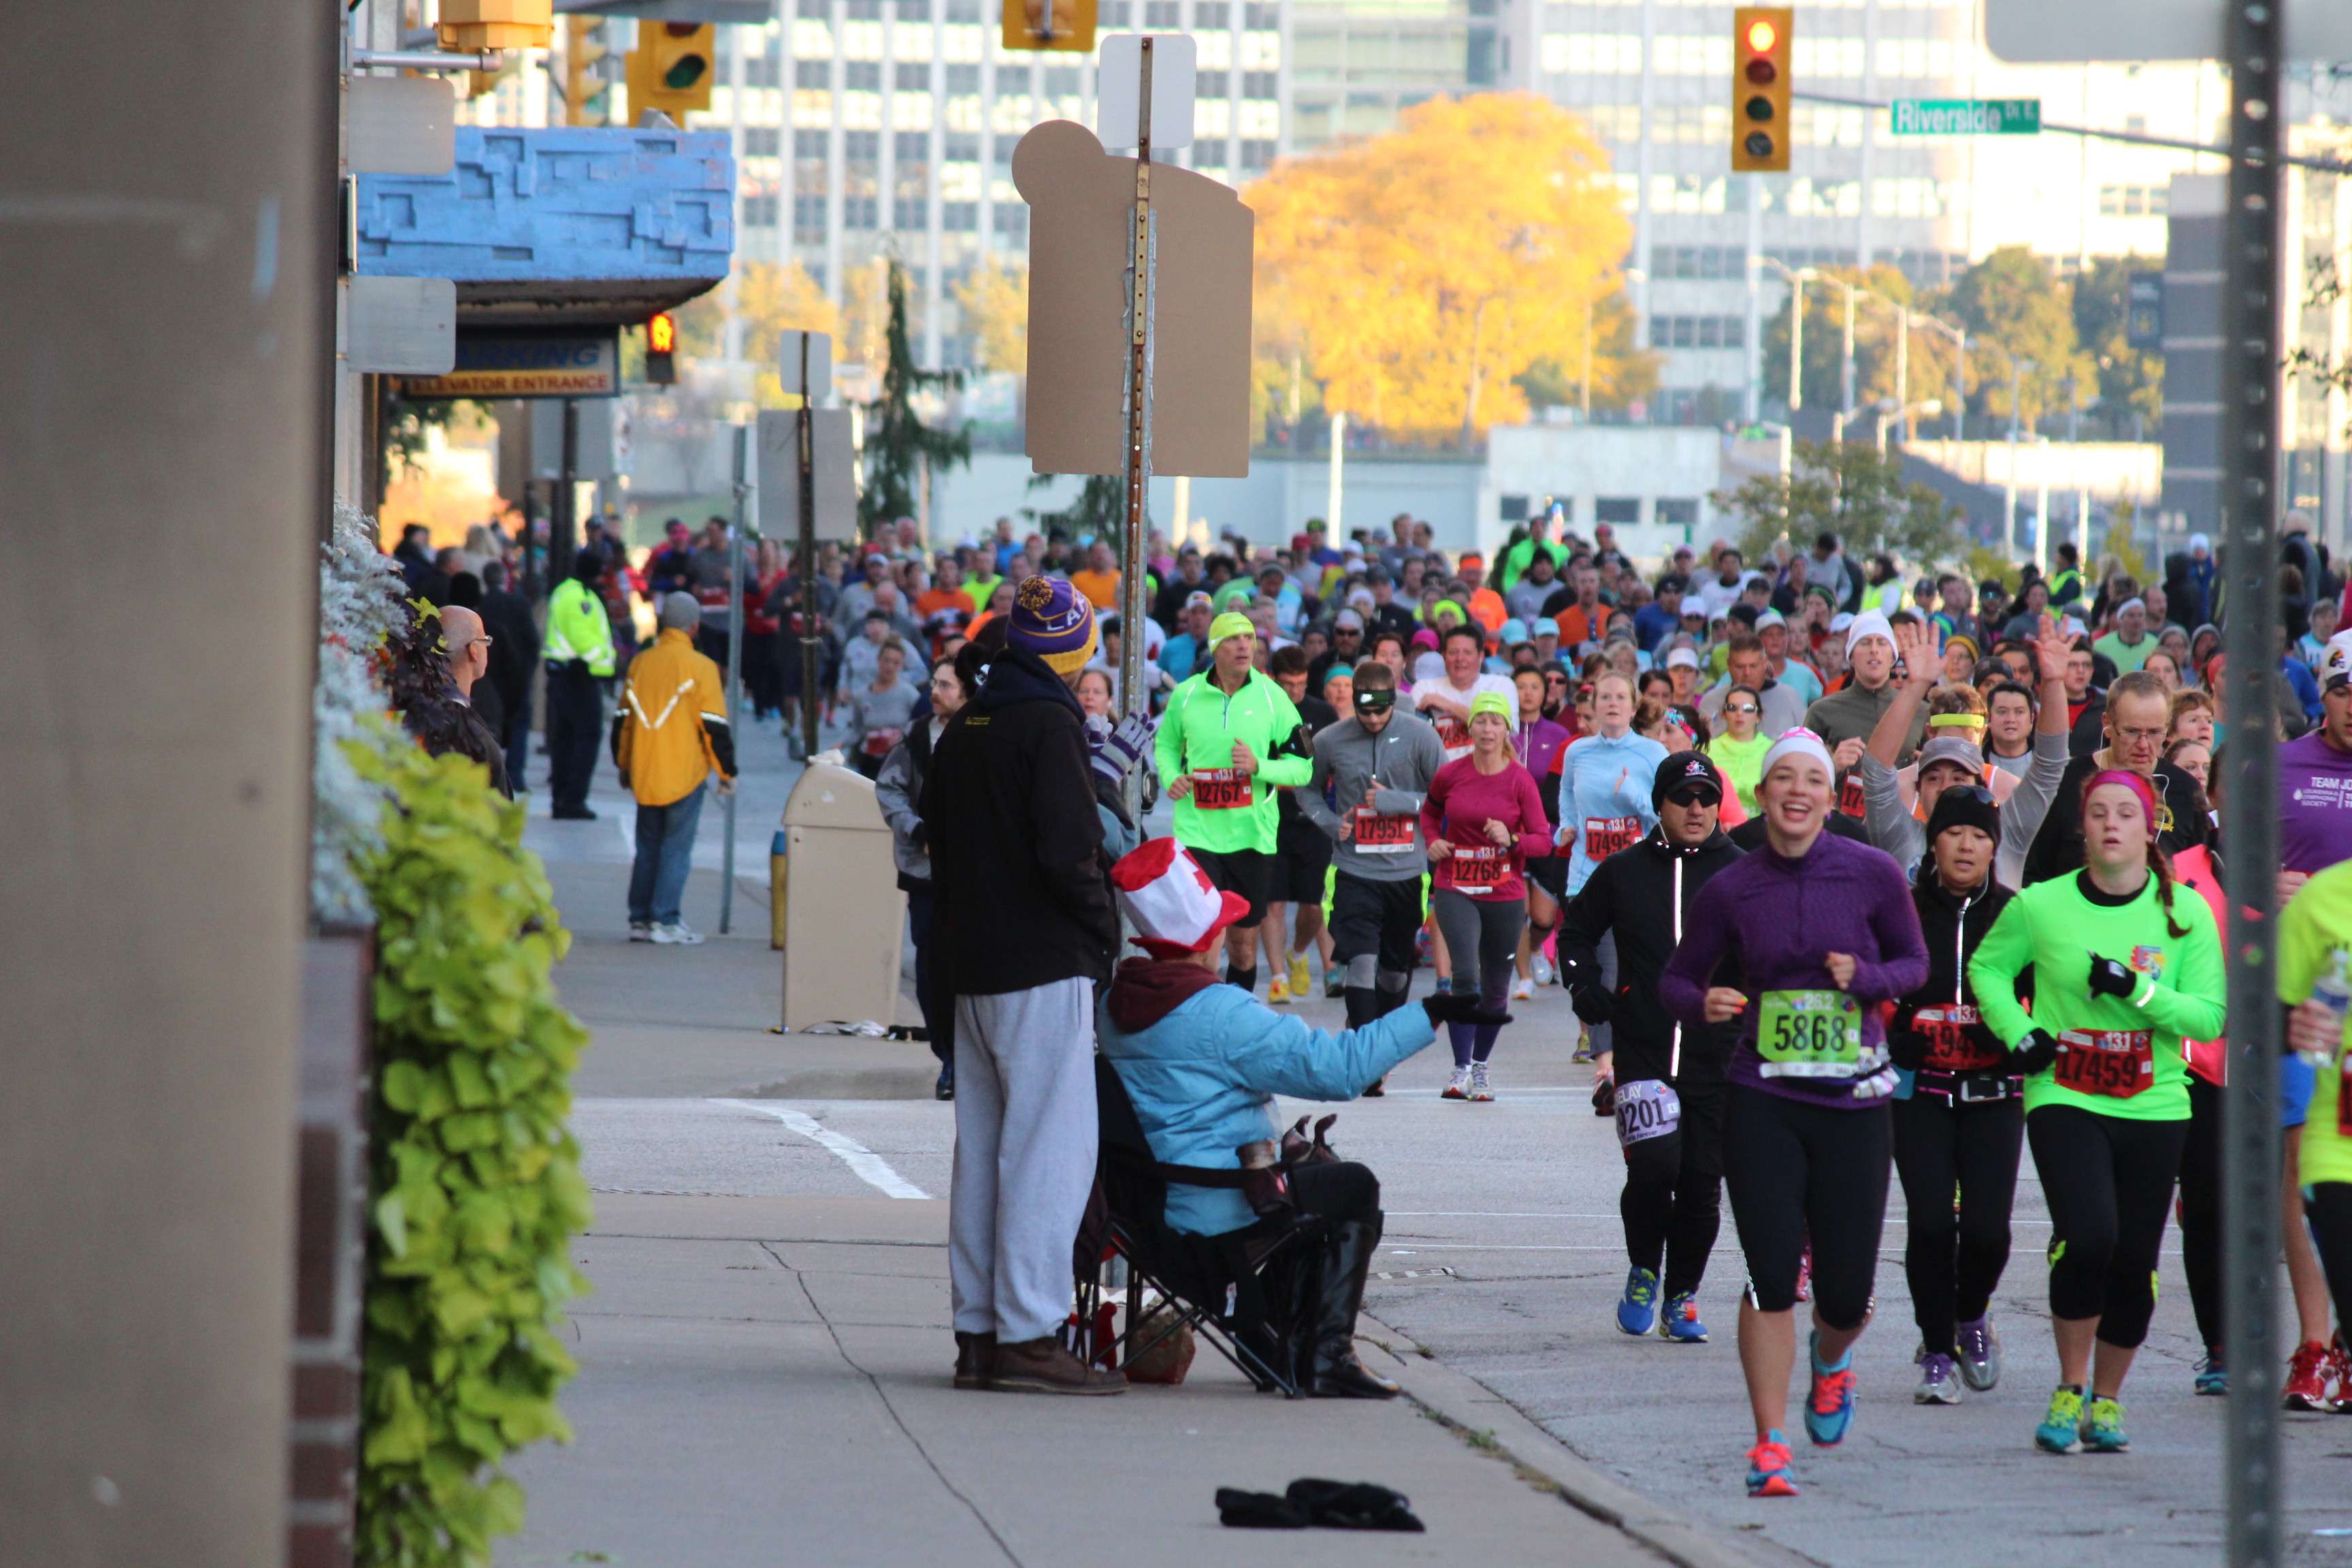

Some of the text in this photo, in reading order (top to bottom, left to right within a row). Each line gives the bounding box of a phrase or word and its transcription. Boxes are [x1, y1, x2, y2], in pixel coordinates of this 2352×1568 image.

[1897, 102, 2001, 132] Riverside
[457, 342, 600, 368] ARKING
[414, 374, 607, 391] ELEVATOR ENTRANCE
[1196, 781, 1241, 803] 12767
[2311, 777, 2340, 788] TEAM
[1359, 817, 1404, 838] 17951
[1587, 832, 1631, 855] 17495
[1454, 860, 1501, 881] 12768
[1805, 992, 1835, 1010] 26.2
[1775, 1015, 1846, 1051] 5868
[2057, 1047, 2138, 1088] 17459
[1616, 1084, 1642, 1104] ELAY
[1617, 1097, 1667, 1138] 9201
